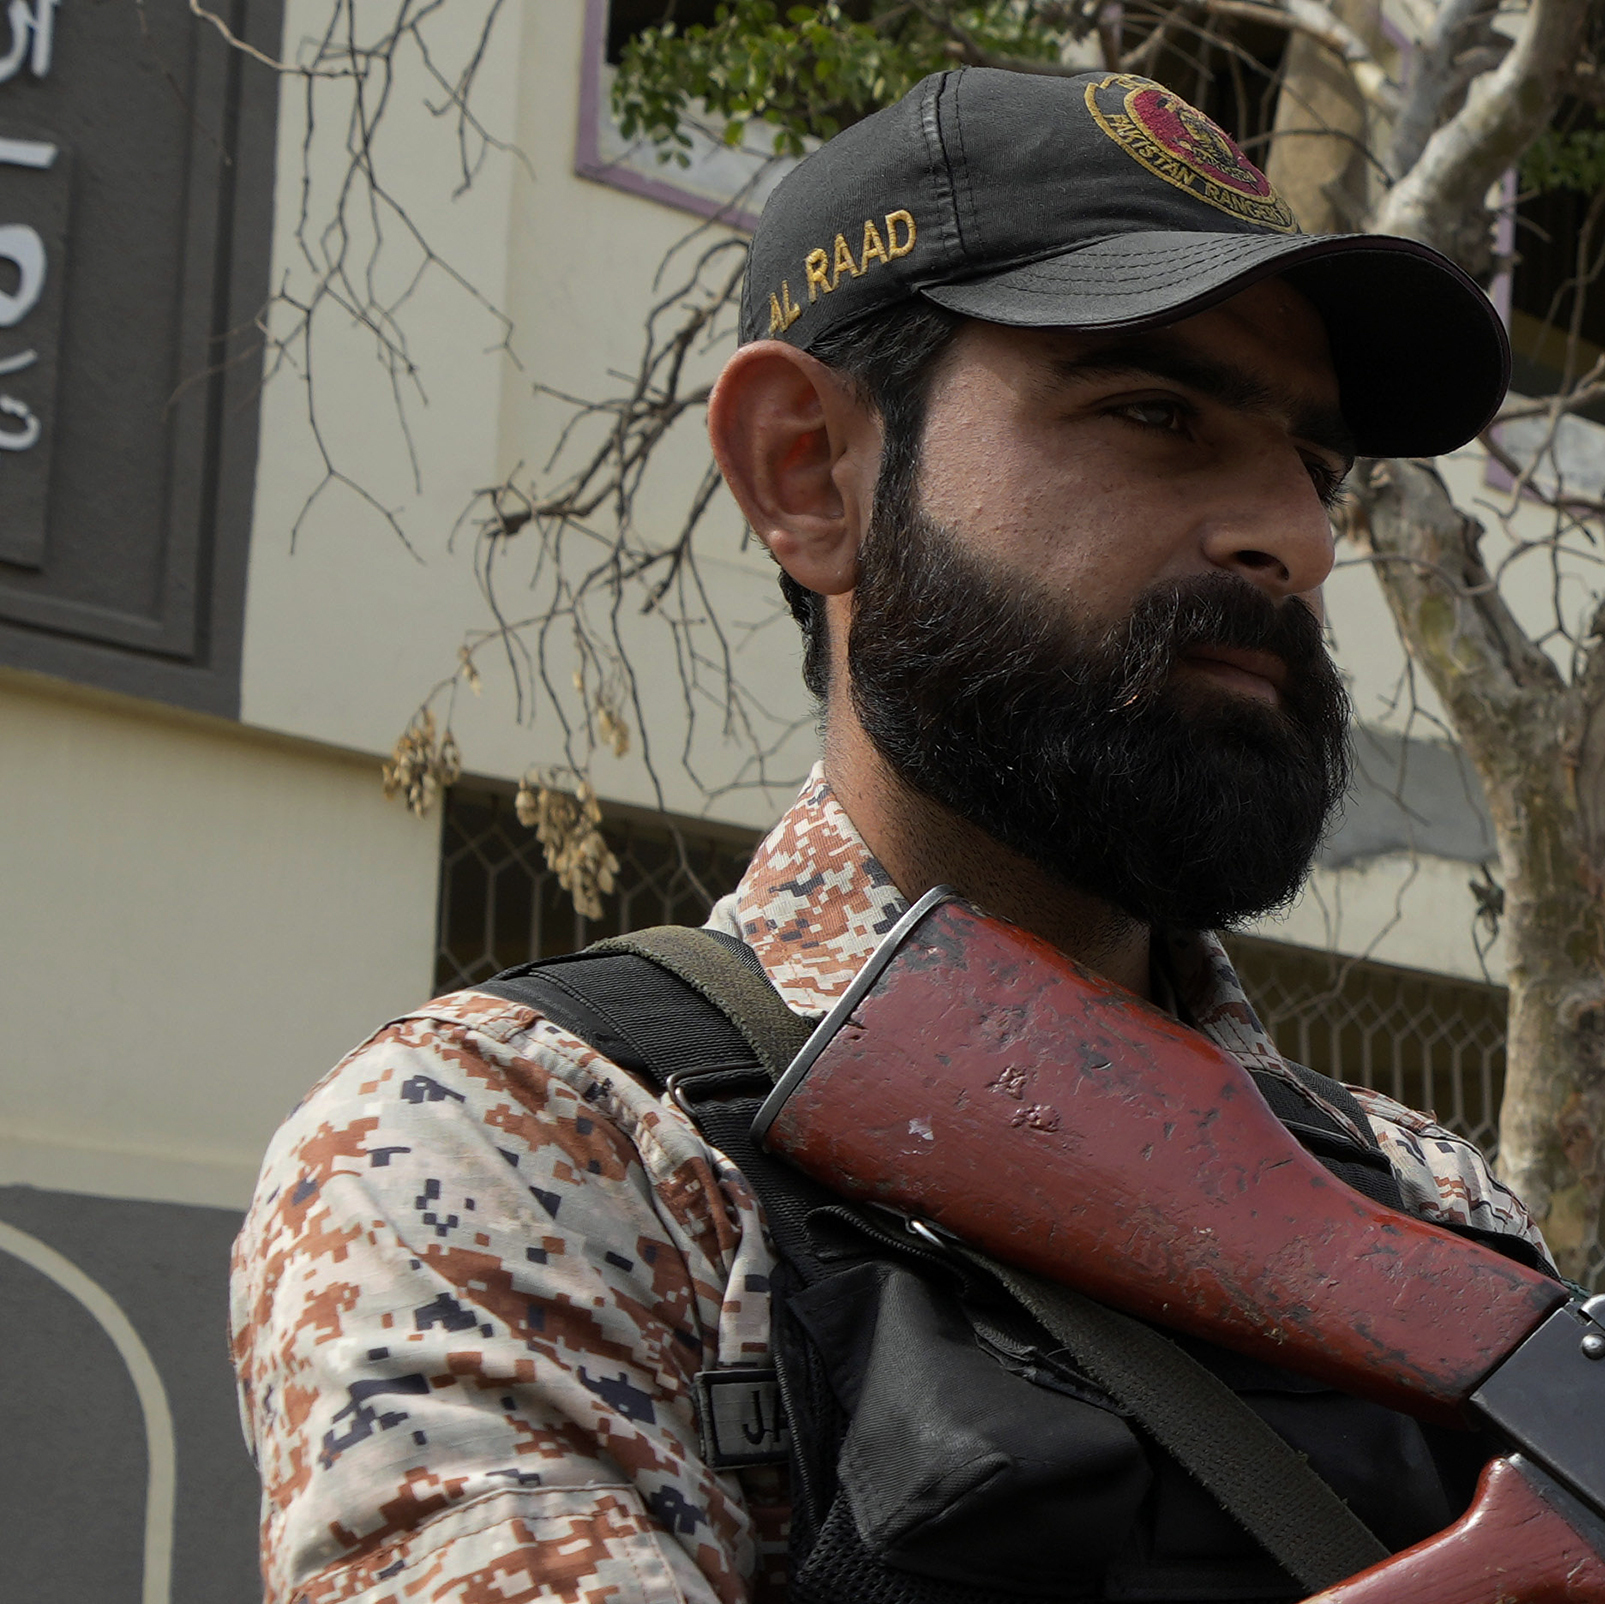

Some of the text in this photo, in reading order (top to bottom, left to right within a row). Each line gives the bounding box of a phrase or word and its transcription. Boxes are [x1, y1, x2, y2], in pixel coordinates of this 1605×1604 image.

[1104, 114, 1198, 184] PAKISTAN
[768, 209, 917, 338] AL RAAD
